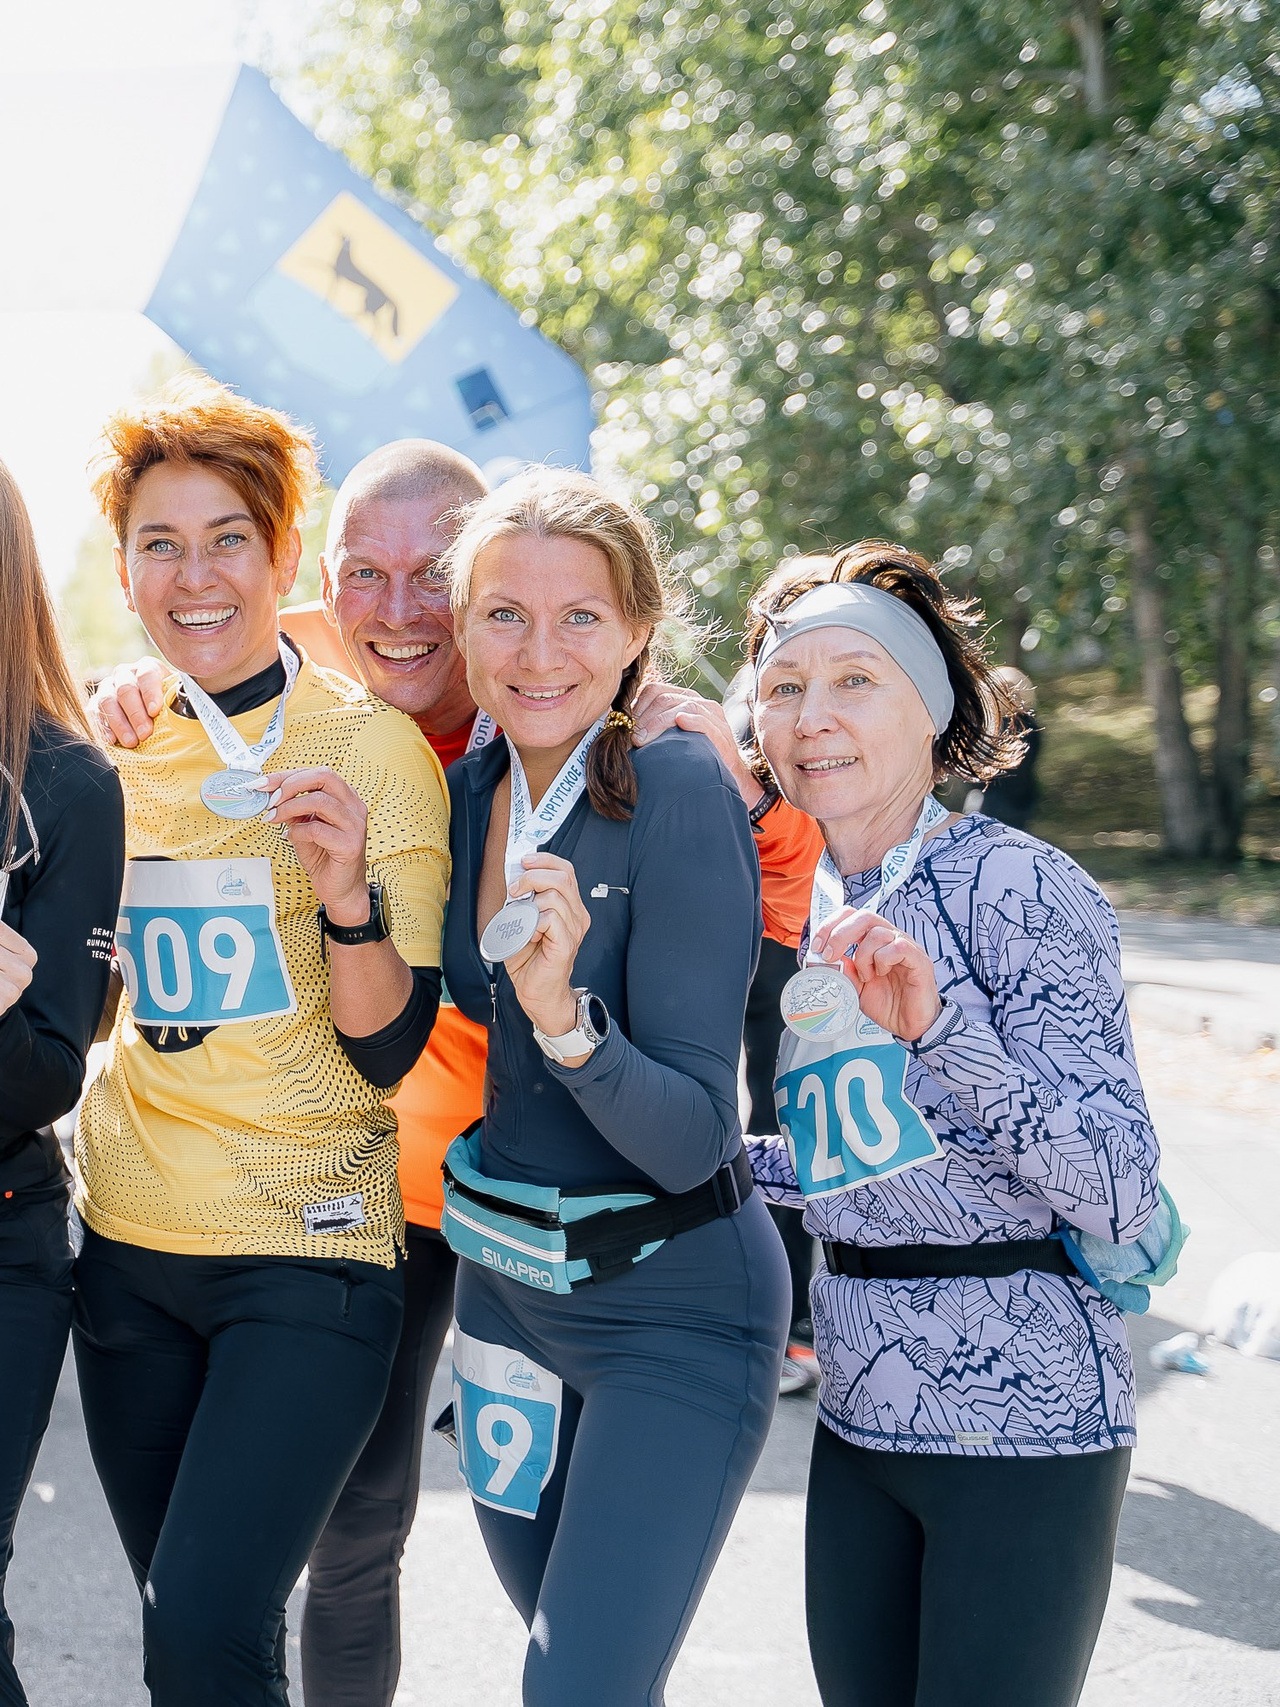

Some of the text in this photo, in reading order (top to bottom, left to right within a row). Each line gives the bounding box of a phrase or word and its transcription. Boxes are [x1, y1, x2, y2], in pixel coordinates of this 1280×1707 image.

[539, 764, 582, 822] СУРГУТСКОЕ
[91, 950, 112, 961] TECH
[481, 1246, 554, 1288] SILAPRO
